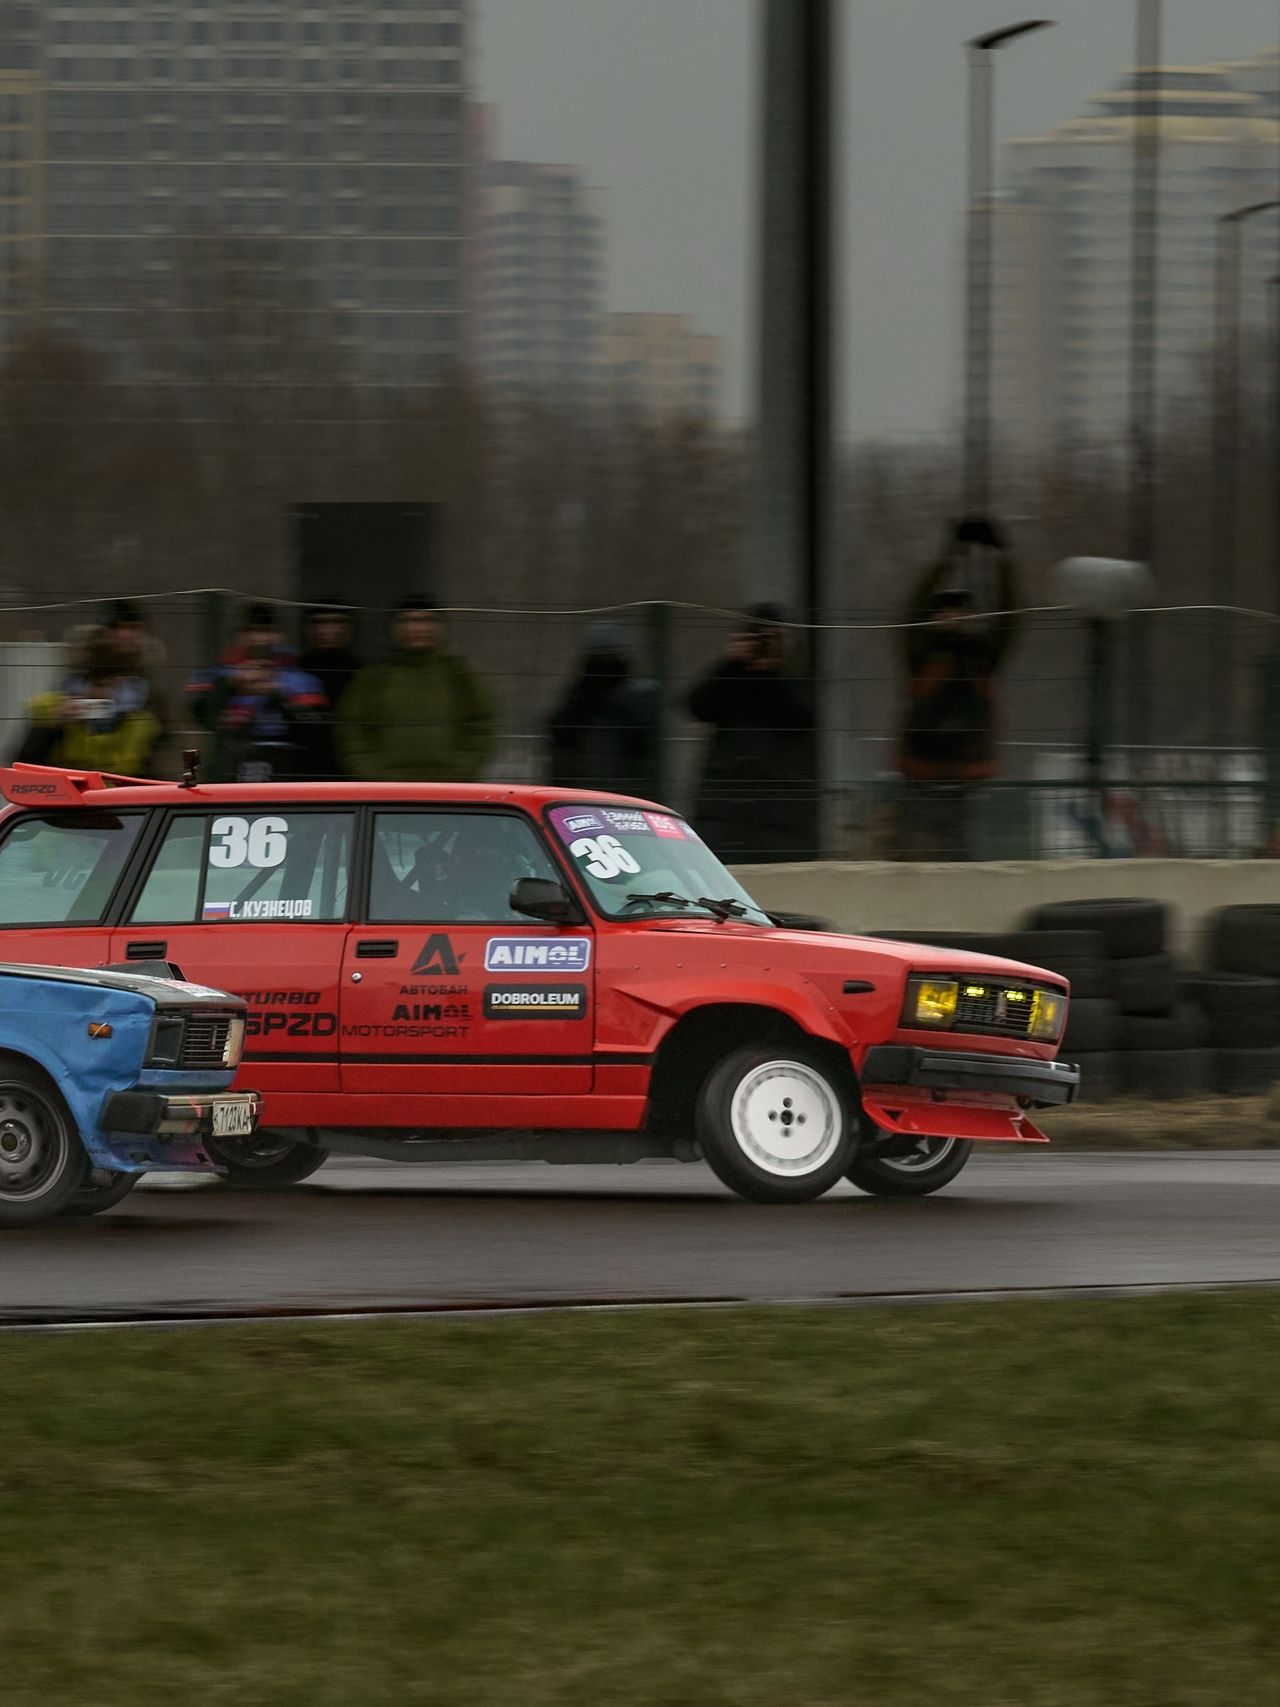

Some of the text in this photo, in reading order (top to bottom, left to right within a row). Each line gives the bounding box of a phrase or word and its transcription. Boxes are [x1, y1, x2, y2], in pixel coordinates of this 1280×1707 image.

[209, 817, 288, 868] 36
[570, 835, 641, 879] 36
[229, 900, 313, 919] С. КУЗНЕЦОВ
[489, 945, 584, 966] AIMOL
[400, 985, 468, 995] АВТОБАН
[491, 993, 579, 1004] DOBROLEUM
[392, 1004, 473, 1021] AIMOL
[247, 1012, 337, 1036] SPZD
[342, 1025, 469, 1037] MOTORSPORT
